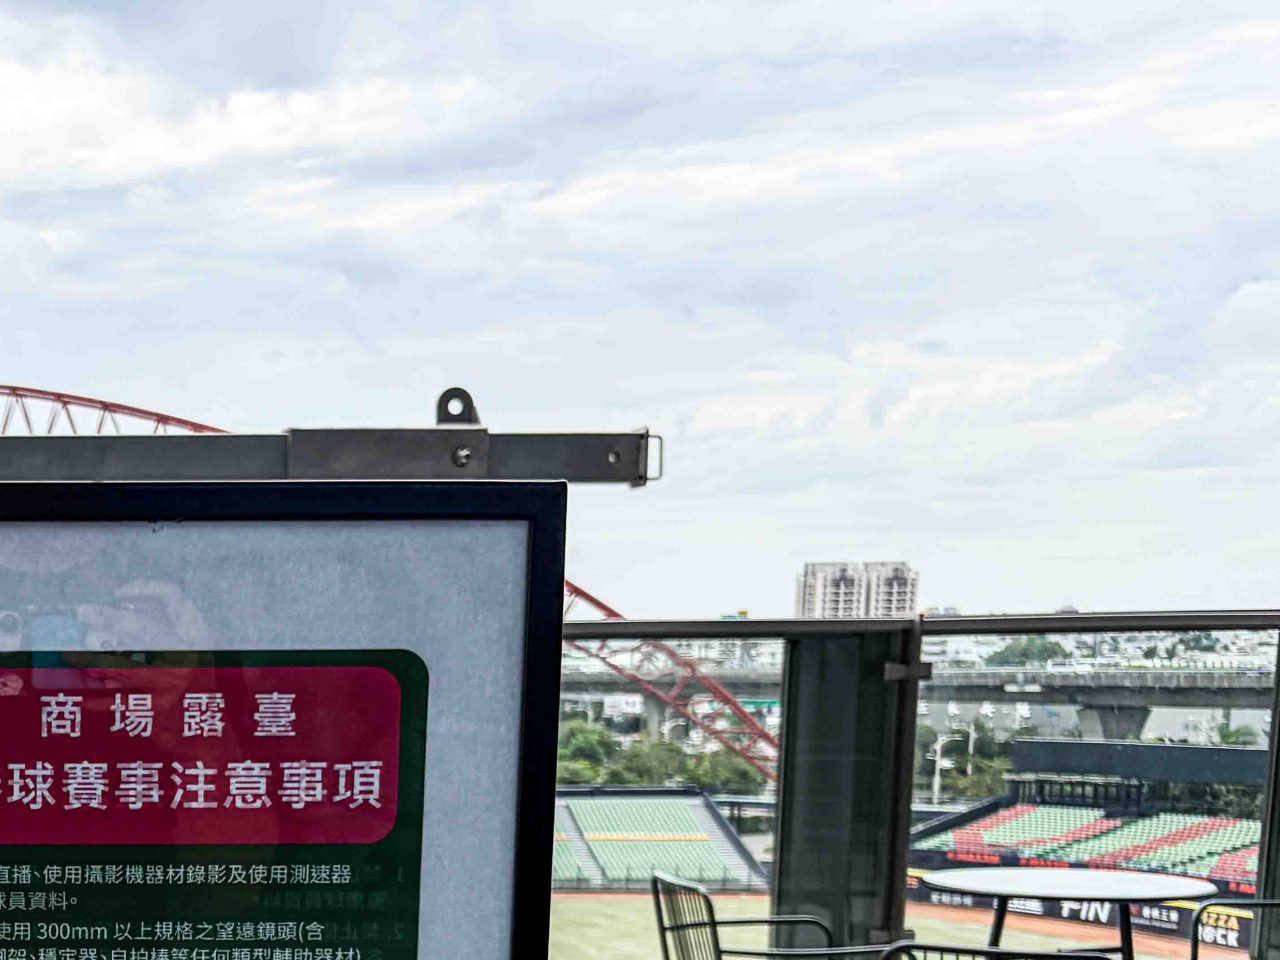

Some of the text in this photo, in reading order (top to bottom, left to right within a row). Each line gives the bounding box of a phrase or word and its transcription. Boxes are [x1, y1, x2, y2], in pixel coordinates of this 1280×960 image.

[40, 692, 296, 738] 商場露臺
[1200, 910, 1240, 931] IZZA
[36, 922, 108, 940] 300mm
[113, 921, 325, 943] 以上規格之望遠鏡頭(含
